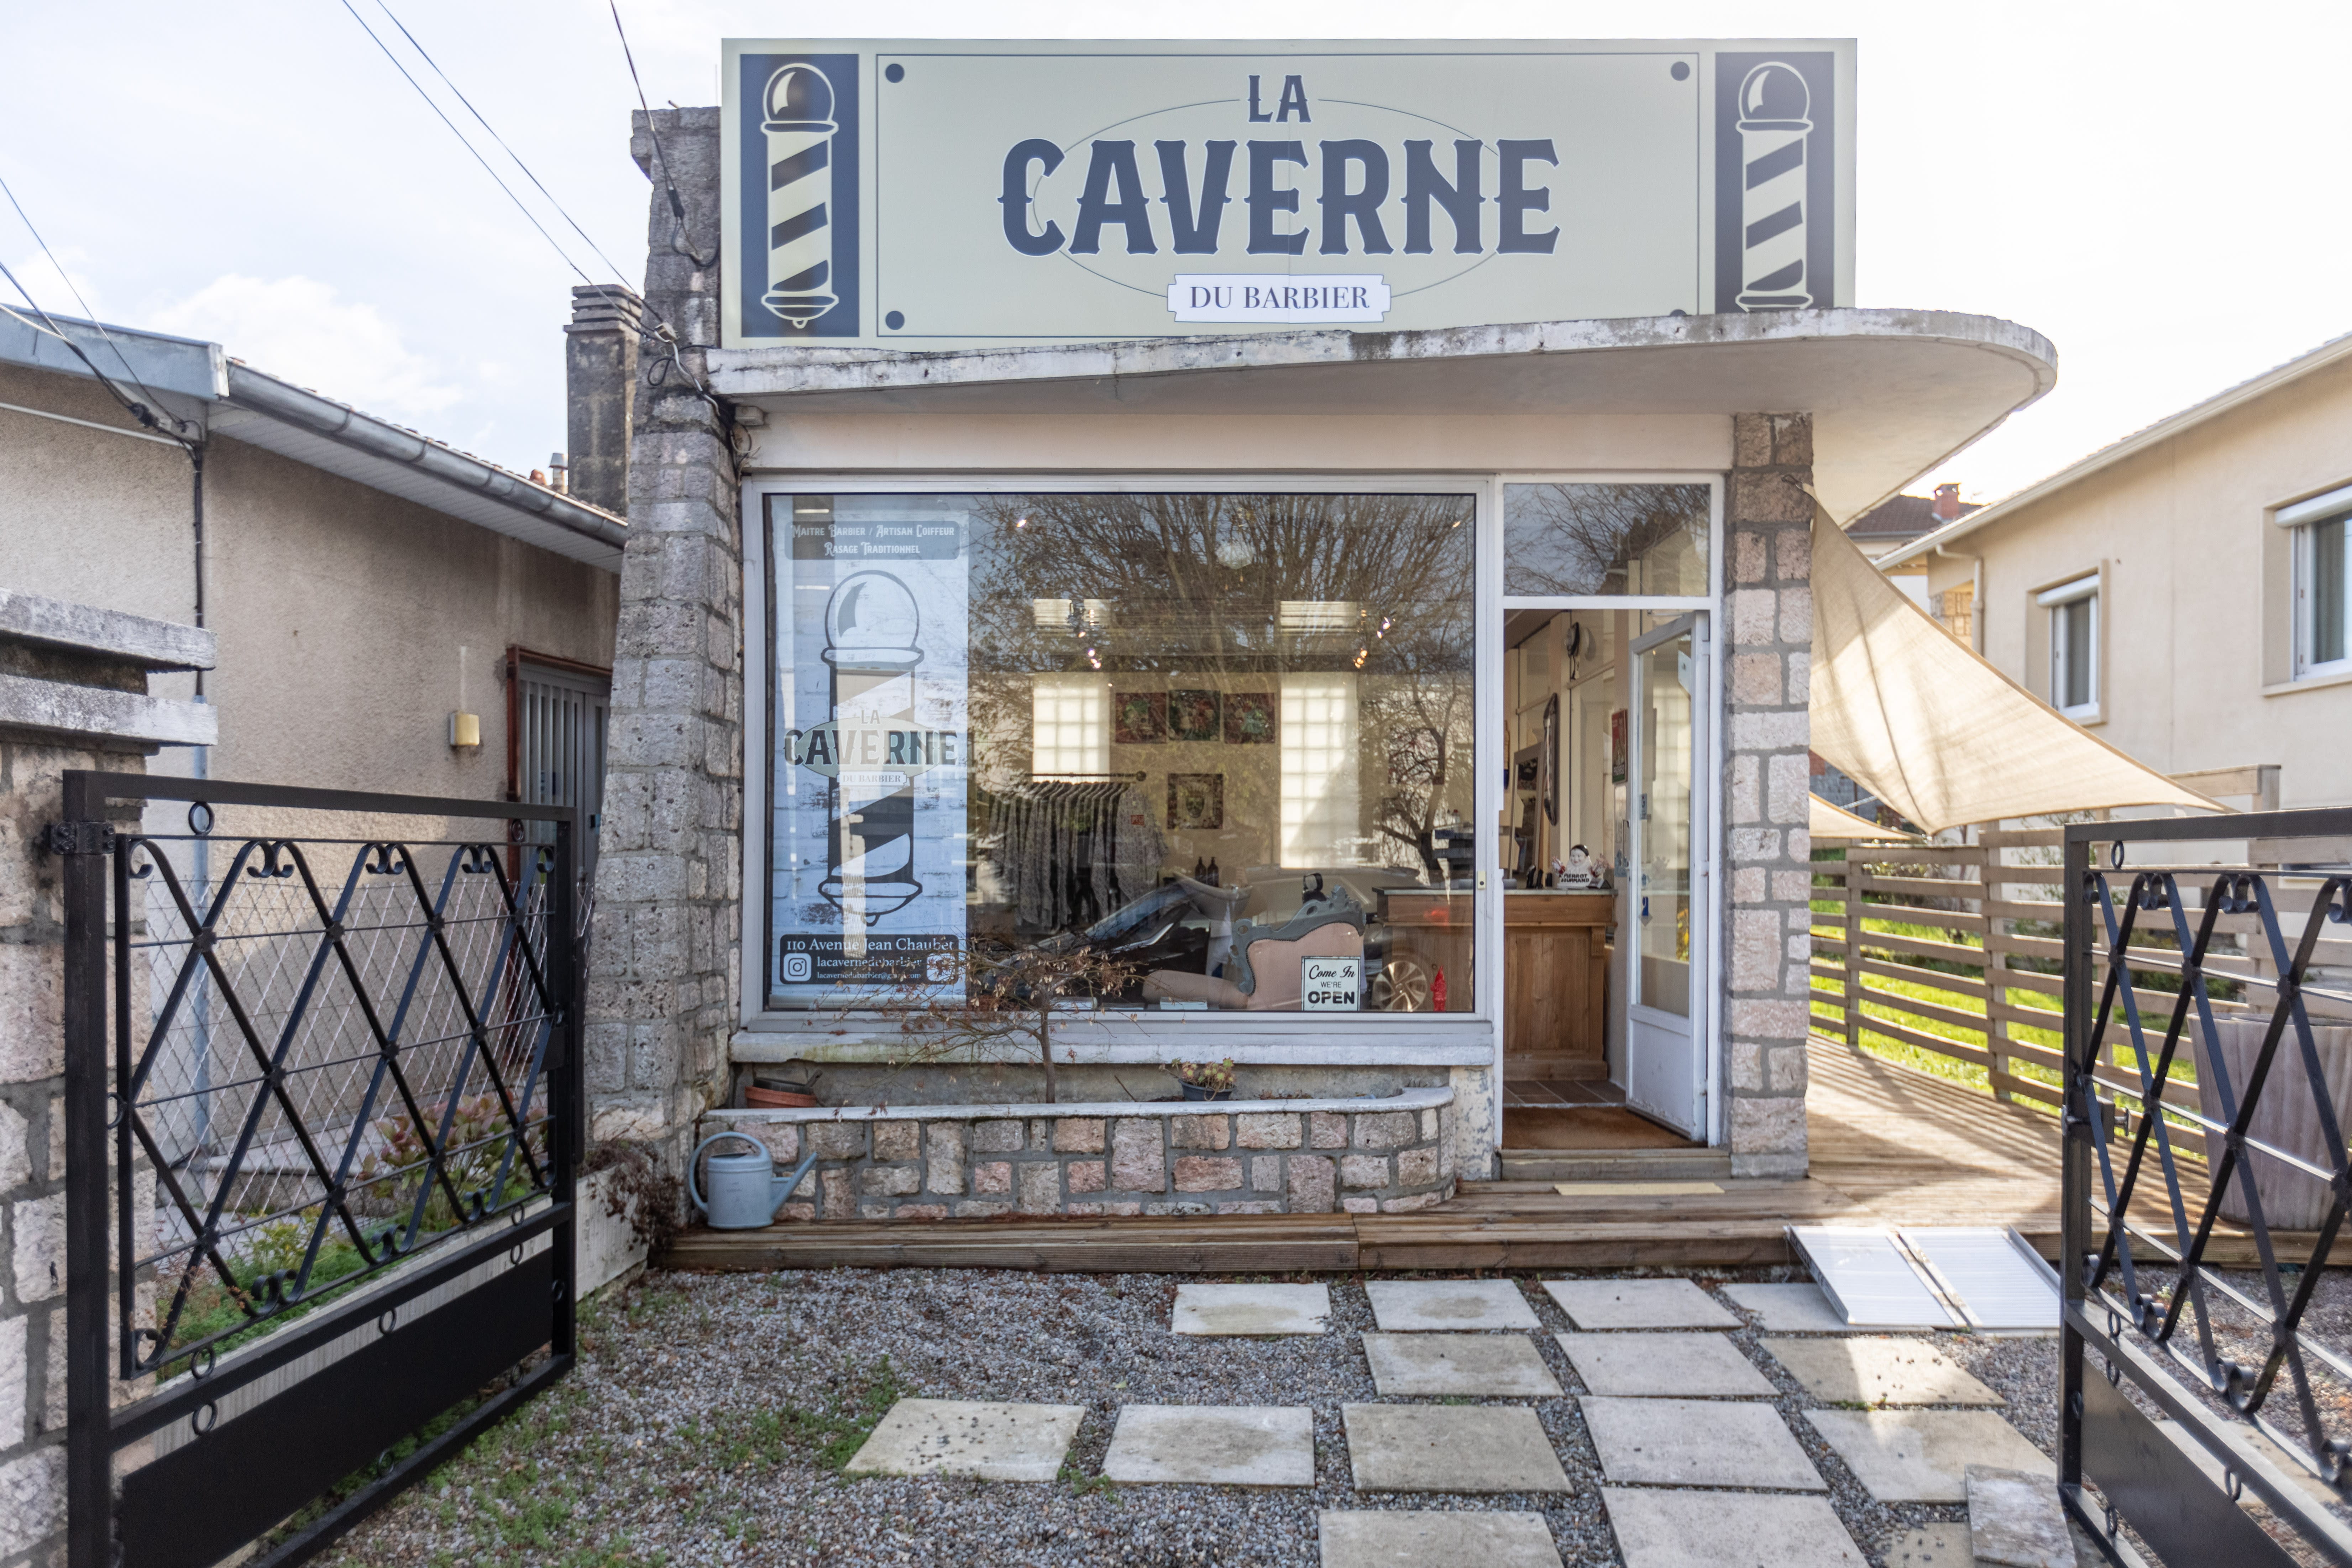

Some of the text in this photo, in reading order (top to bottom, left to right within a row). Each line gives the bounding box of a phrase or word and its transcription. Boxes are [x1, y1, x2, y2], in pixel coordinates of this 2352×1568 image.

[1247, 74, 1311, 123] LA
[997, 137, 1561, 257] CAVERNE
[1189, 286, 1370, 309] DU BARBIER
[828, 524, 865, 537] BARBIER
[876, 524, 913, 538] ARTISAN
[916, 524, 954, 537] COIFFEUR
[824, 542, 920, 557] RASAGE TRADITIONNEL
[861, 709, 880, 724] LA
[783, 729, 958, 766] CAVERNE
[787, 938, 954, 953] 110 Avenue Jean Chaubet
[1309, 965, 1356, 980] Come In
[1308, 991, 1355, 1004] OPEN
